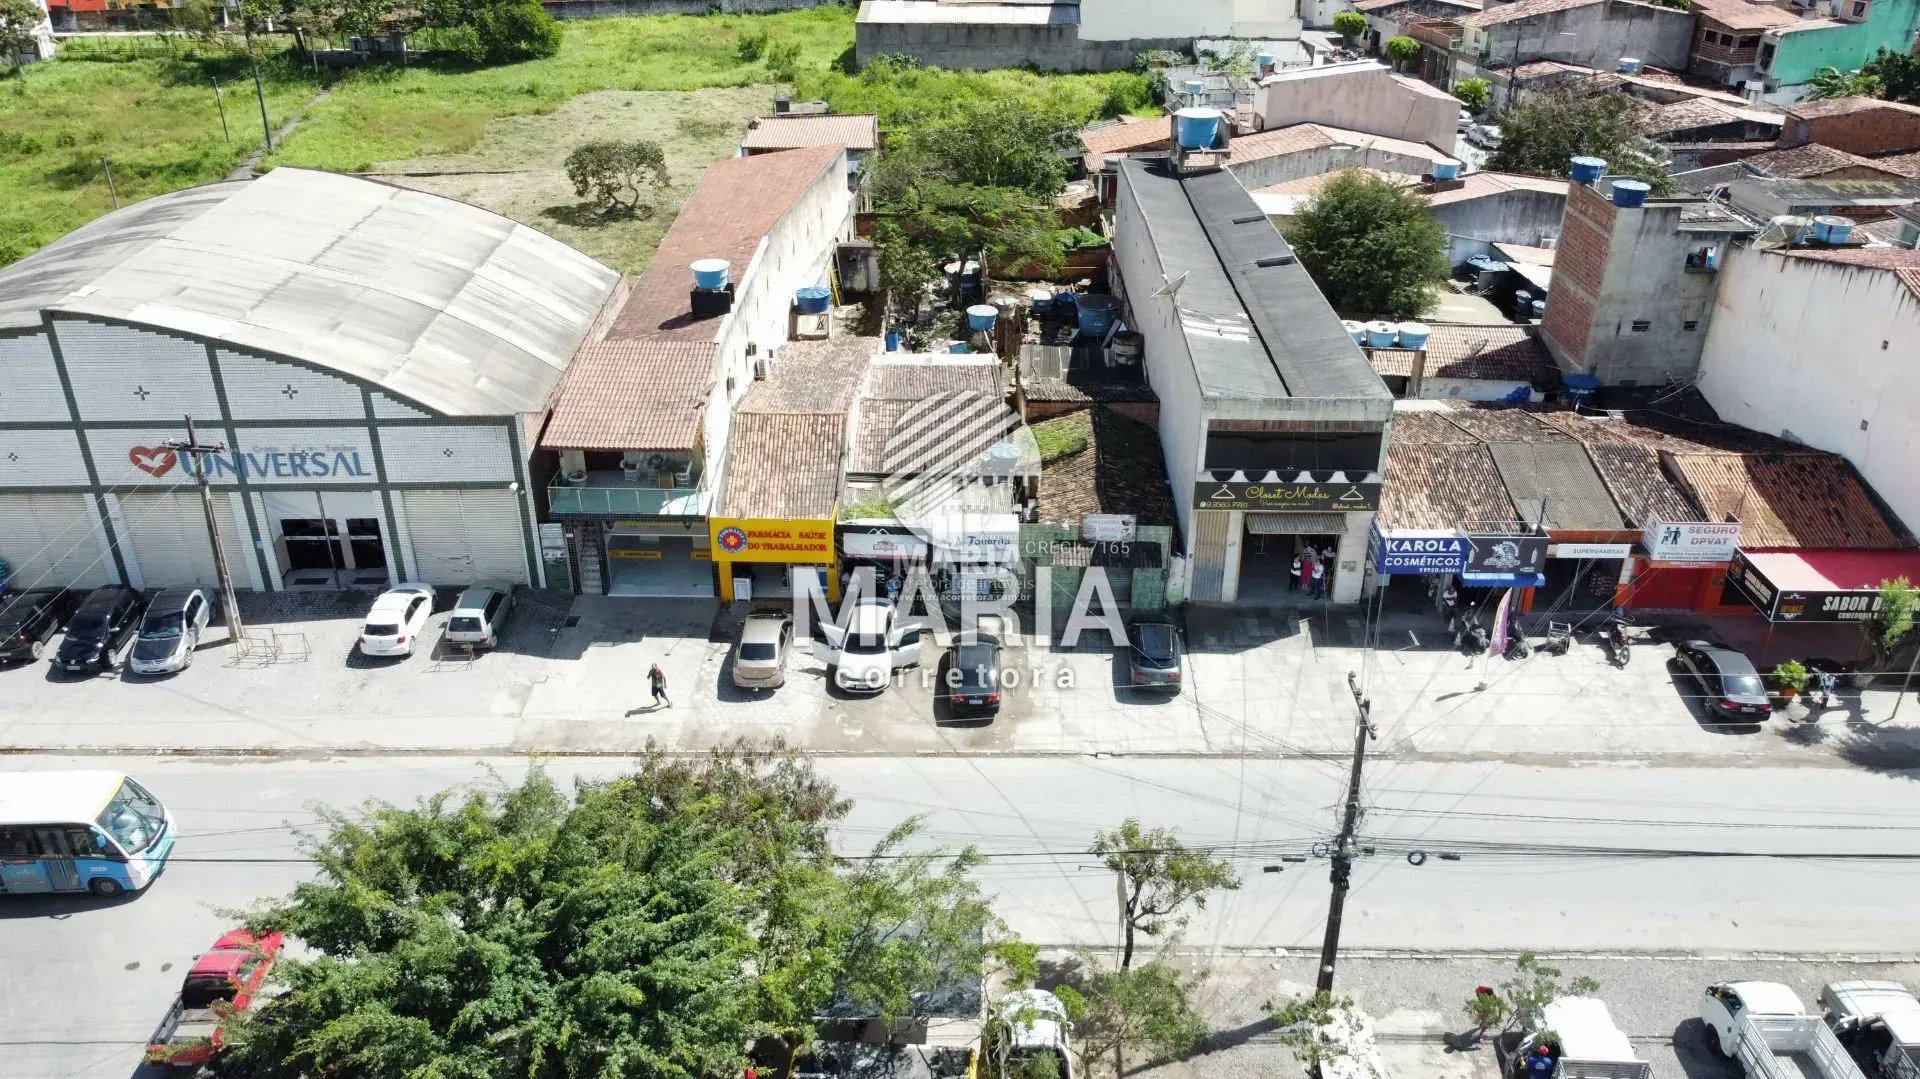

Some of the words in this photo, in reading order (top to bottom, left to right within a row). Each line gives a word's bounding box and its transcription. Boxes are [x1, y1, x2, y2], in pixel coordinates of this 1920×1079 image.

[179, 451, 371, 478] UNIVERSAL
[1245, 486, 1285, 499] Closet
[1285, 486, 1329, 499] Modas
[1688, 526, 1738, 535] SEGURO
[1387, 540, 1461, 552] KAROLA
[1691, 537, 1729, 545] DPVAT
[761, 543, 827, 552] TRABALHADOR
[1384, 556, 1460, 566] COSMÉTICOS
[1822, 596, 1869, 611] SABOR
